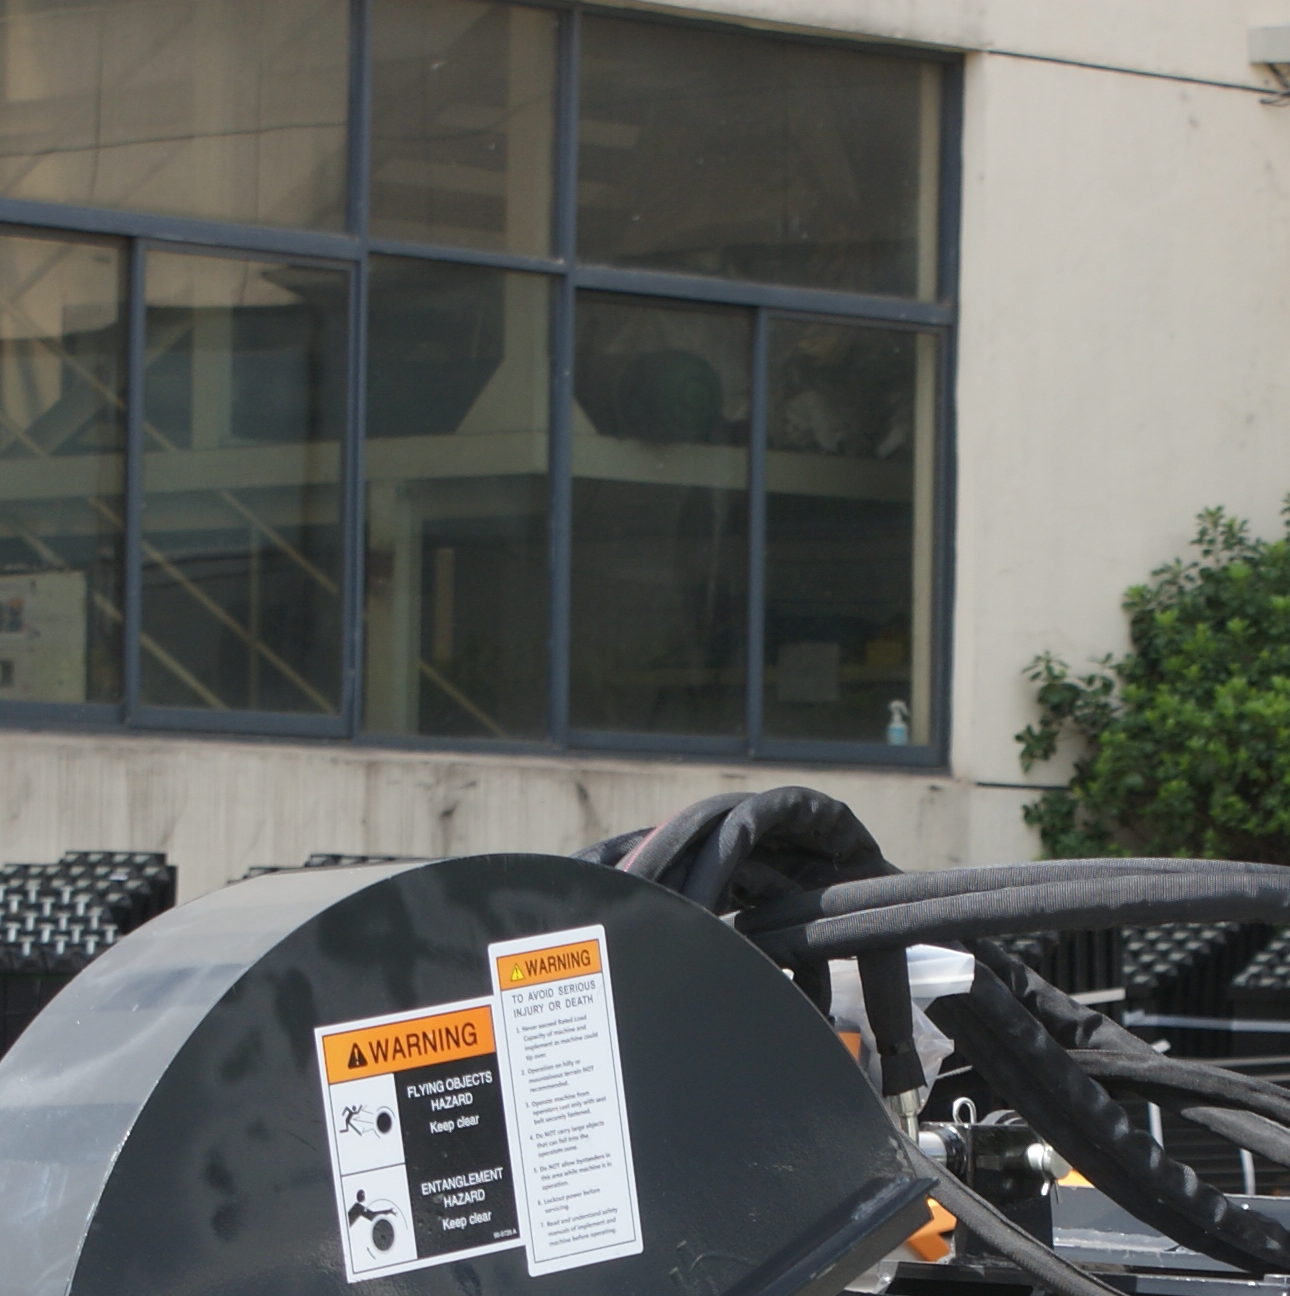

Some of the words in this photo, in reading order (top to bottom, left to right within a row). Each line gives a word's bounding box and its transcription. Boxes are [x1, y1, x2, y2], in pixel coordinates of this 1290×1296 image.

[525, 950, 590, 976] WARNING
[511, 994, 524, 1004] TO
[528, 988, 554, 1000] AVOID
[558, 980, 595, 995] SERIOUS
[513, 1004, 543, 1018] INJURY
[548, 1000, 561, 1011] OR
[565, 995, 593, 1008] DEATH
[369, 1023, 477, 1062] WARNING
[407, 1080, 444, 1098] FLYING
[446, 1071, 492, 1090] OBJECTS
[431, 1092, 473, 1110] HAZARD
[430, 1120, 455, 1133] Keep
[457, 1115, 479, 1128] clear
[421, 1167, 502, 1195] ENTANGLEMENT
[444, 1189, 485, 1207] HAZARD
[442, 1217, 467, 1230] Keep
[469, 1211, 492, 1225] clear
